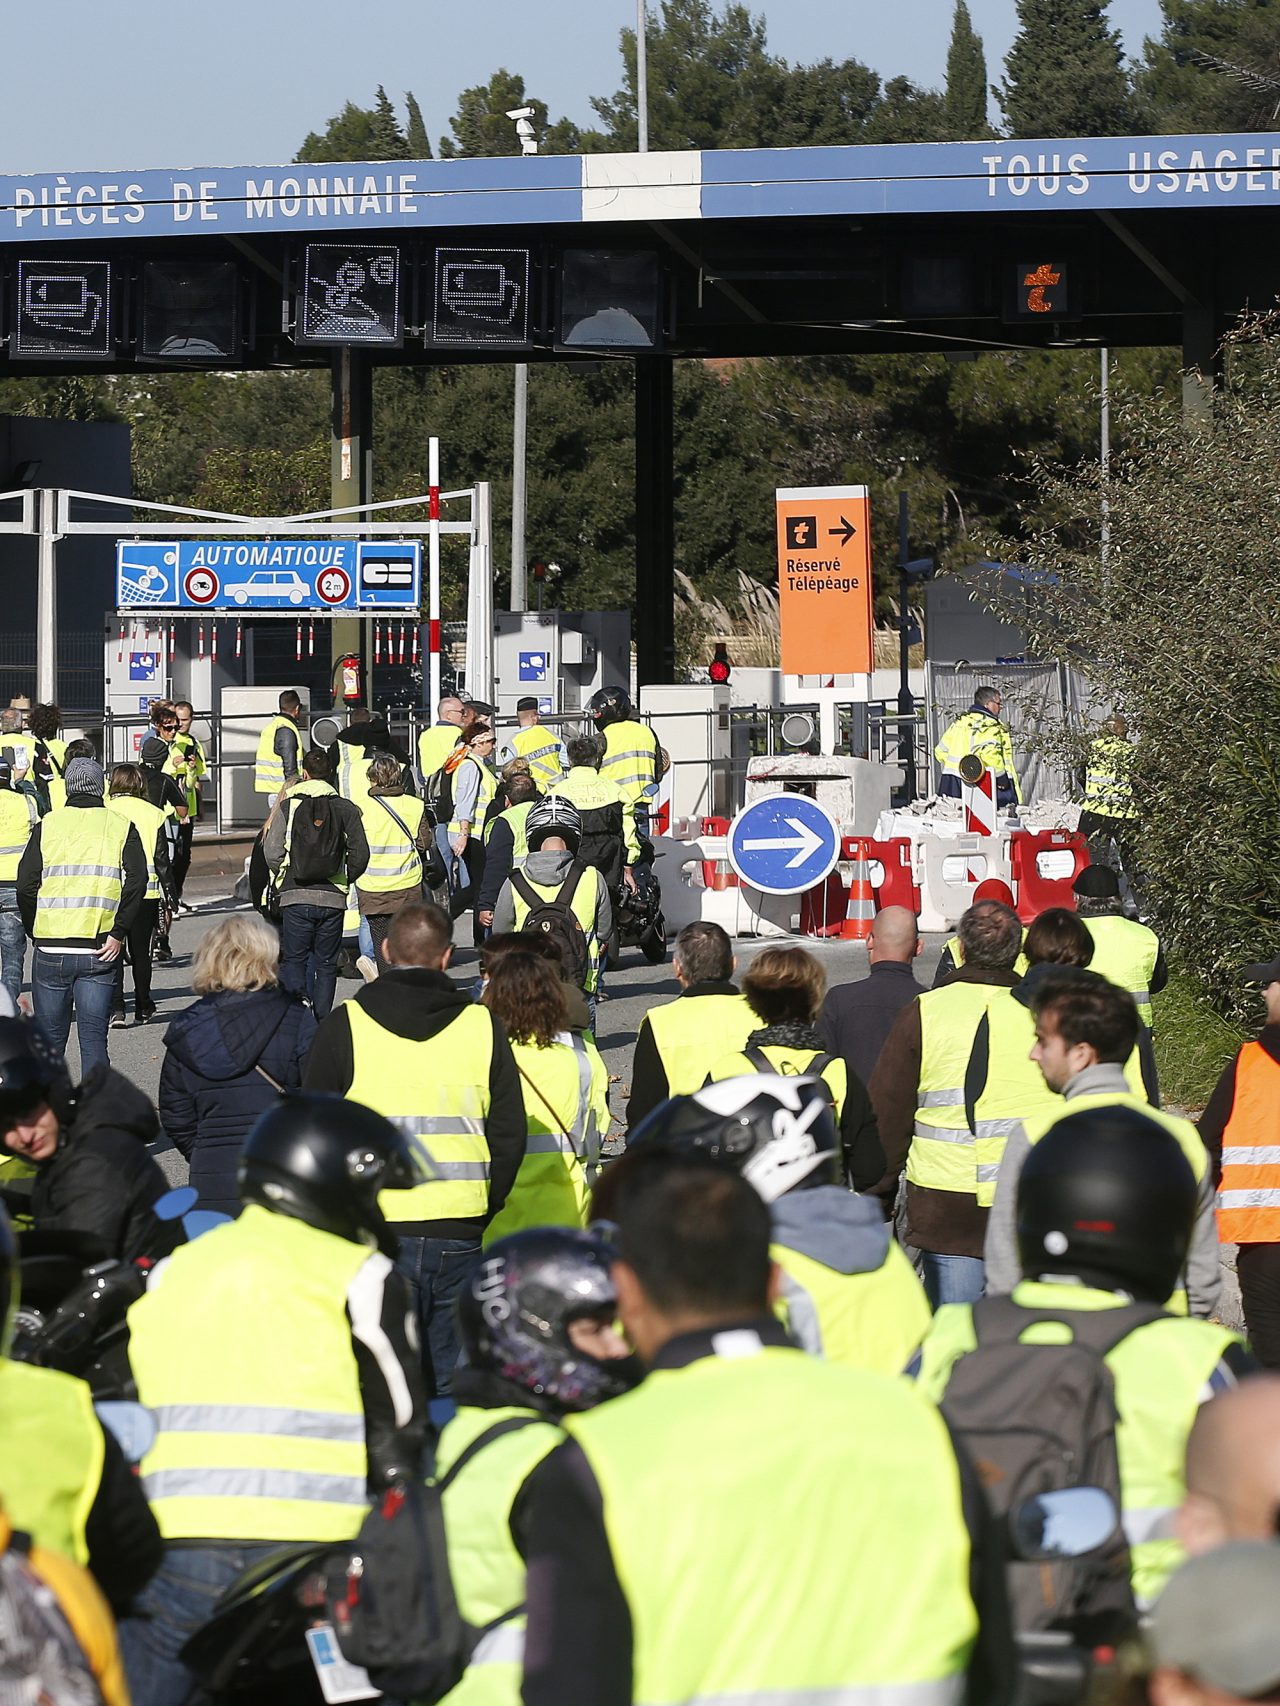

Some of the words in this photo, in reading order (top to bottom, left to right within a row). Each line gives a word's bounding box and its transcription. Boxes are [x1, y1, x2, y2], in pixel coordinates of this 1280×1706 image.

[983, 152, 1089, 198] TOUS
[15, 175, 144, 228] PIÈCES
[173, 180, 219, 223] DE
[246, 173, 418, 220] MONNAIE
[191, 546, 345, 566] AUTOMATIQUE
[786, 557, 841, 573] Réservé
[325, 580, 332, 591] 2
[333, 583, 342, 591] m
[787, 575, 859, 594] Télépéage
[471, 1256, 512, 1329] HJC
